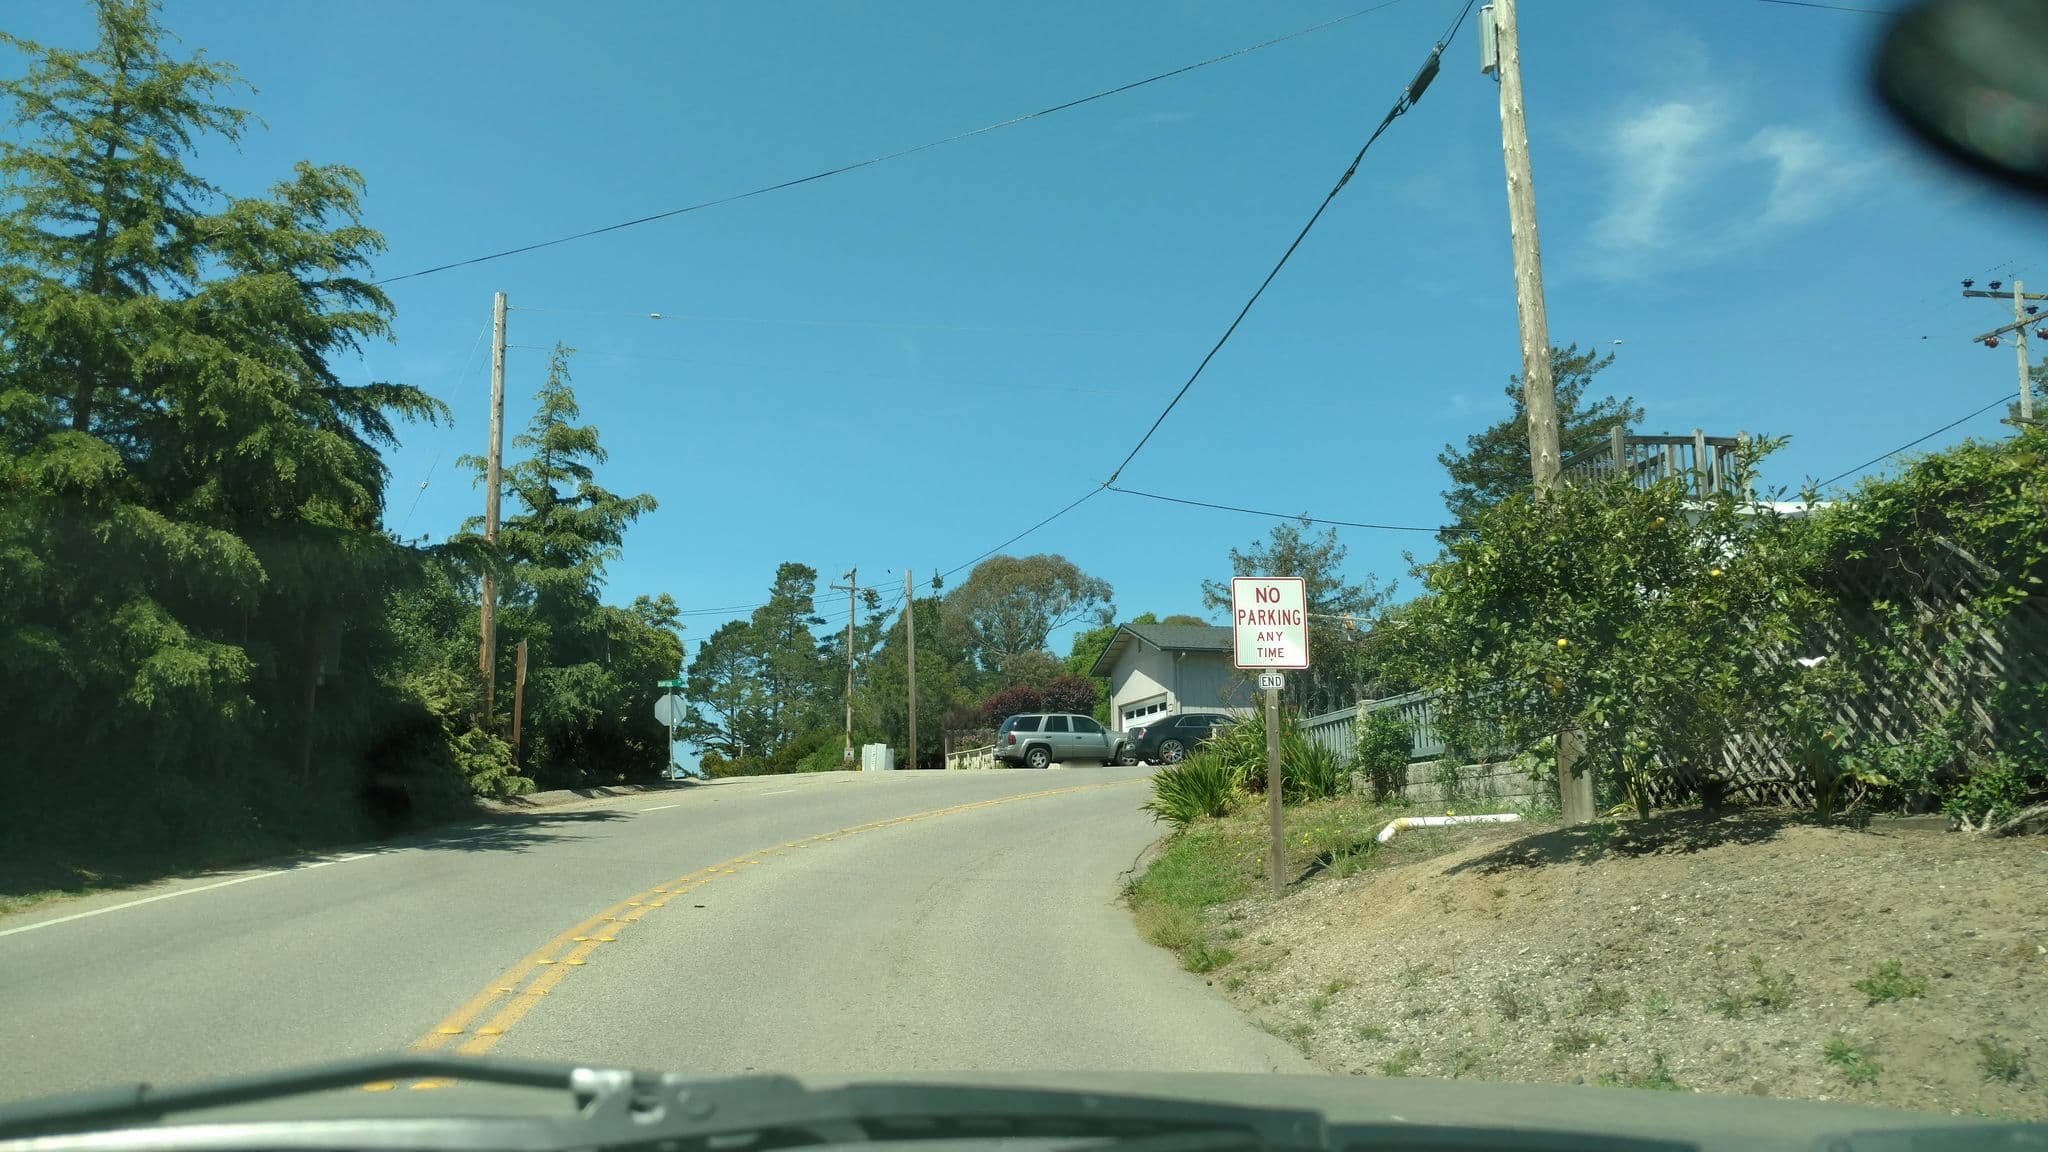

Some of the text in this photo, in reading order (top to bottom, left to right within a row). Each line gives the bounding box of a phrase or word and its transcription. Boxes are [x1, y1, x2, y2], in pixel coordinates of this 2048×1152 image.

[1255, 587, 1280, 603] NO
[1238, 609, 1301, 626] PARKING
[1257, 631, 1283, 642] ANY
[1257, 647, 1284, 658] TIME
[1261, 676, 1282, 687] END
